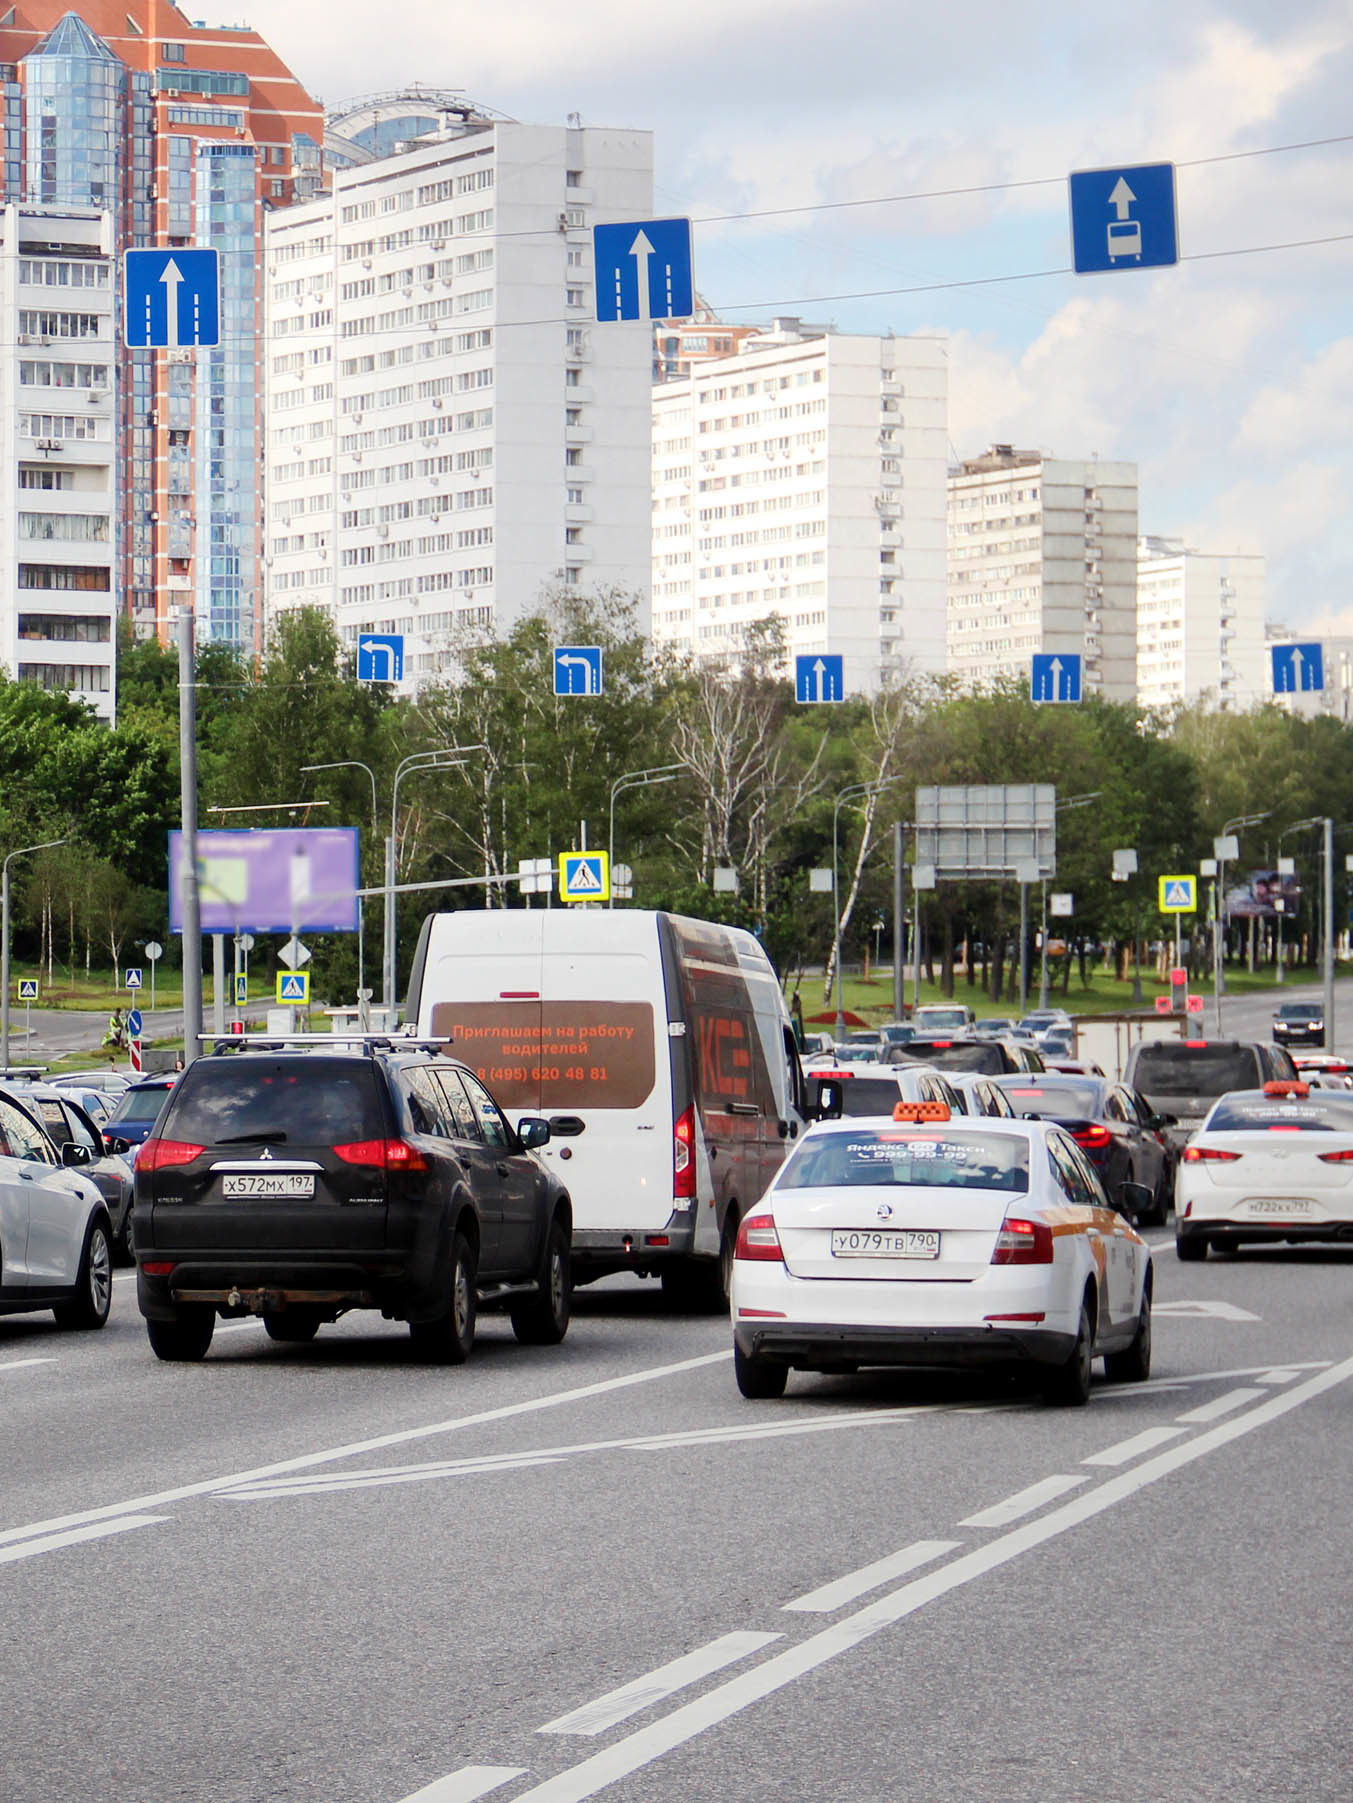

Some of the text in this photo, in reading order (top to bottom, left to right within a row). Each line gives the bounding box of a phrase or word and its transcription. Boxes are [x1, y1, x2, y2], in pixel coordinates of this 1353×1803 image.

[453, 1023, 634, 1040] Приглашаем на работу
[502, 1040, 588, 1056] водителей
[490, 1066, 528, 1082] (495)
[531, 1067, 560, 1080] 620
[565, 1067, 585, 1080] 48
[590, 1067, 608, 1080] 81
[847, 1143, 905, 1152] Яндекс
[940, 1143, 985, 1153] Такси
[874, 1151, 967, 1159] 999-99-99
[289, 1176, 310, 1189] 197
[908, 1233, 935, 1247] 790
